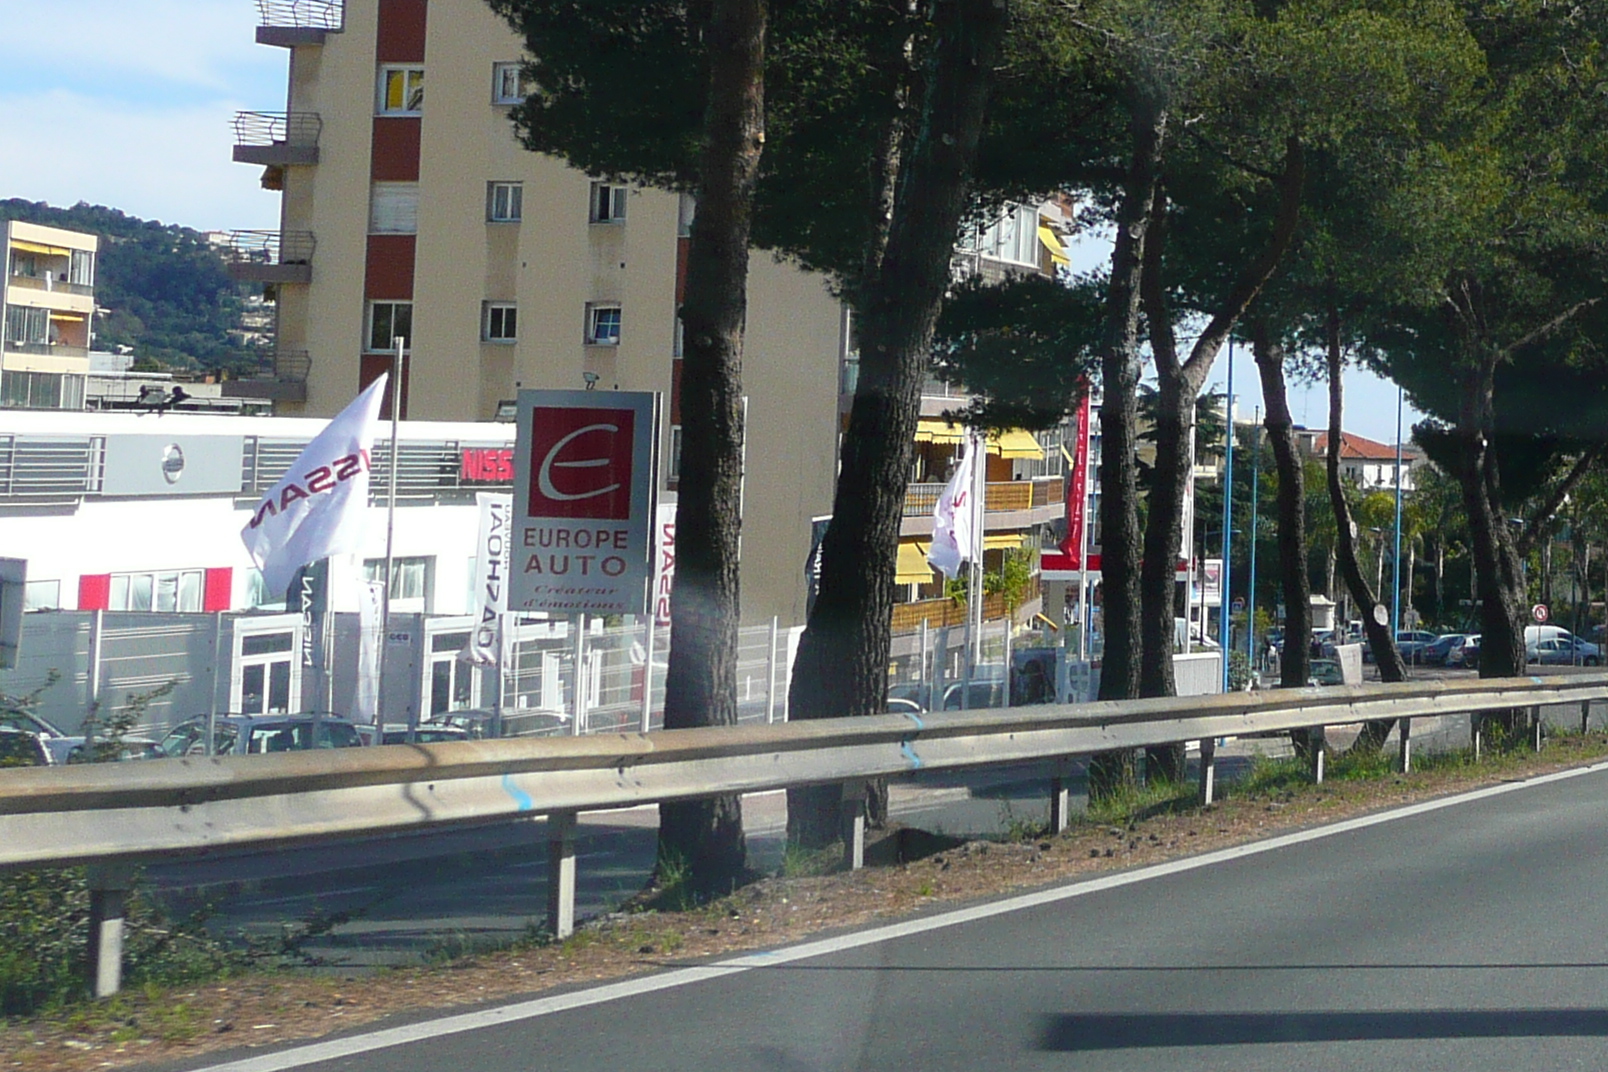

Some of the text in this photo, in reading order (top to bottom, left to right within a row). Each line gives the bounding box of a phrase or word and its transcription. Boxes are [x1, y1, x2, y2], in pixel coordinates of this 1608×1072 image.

[462, 448, 515, 481] NISS
[524, 528, 629, 550] EUROPE
[523, 553, 627, 577] AUTO
